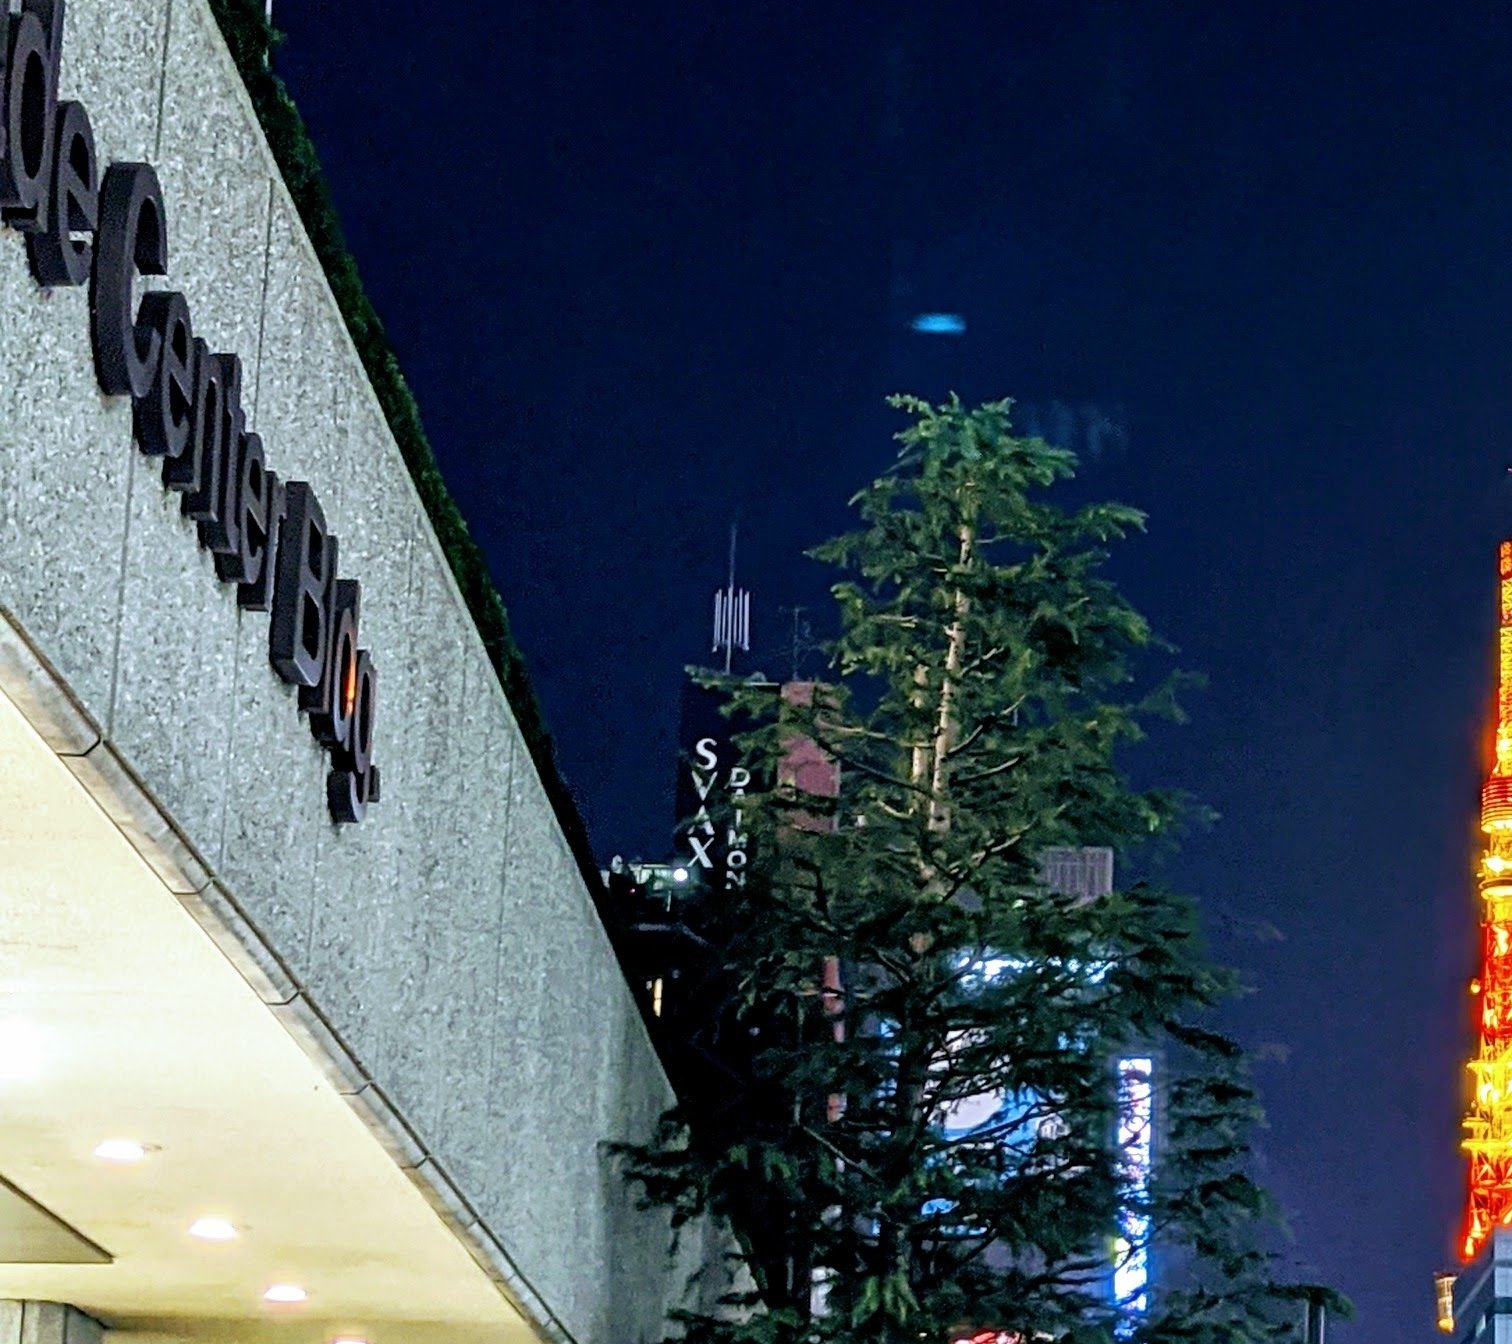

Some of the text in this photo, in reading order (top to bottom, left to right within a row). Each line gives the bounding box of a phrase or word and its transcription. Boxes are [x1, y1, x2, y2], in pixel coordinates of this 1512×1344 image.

[91, 161, 288, 612] Center
[269, 480, 381, 824] Bldg.
[687, 737, 719, 869] SVAX
